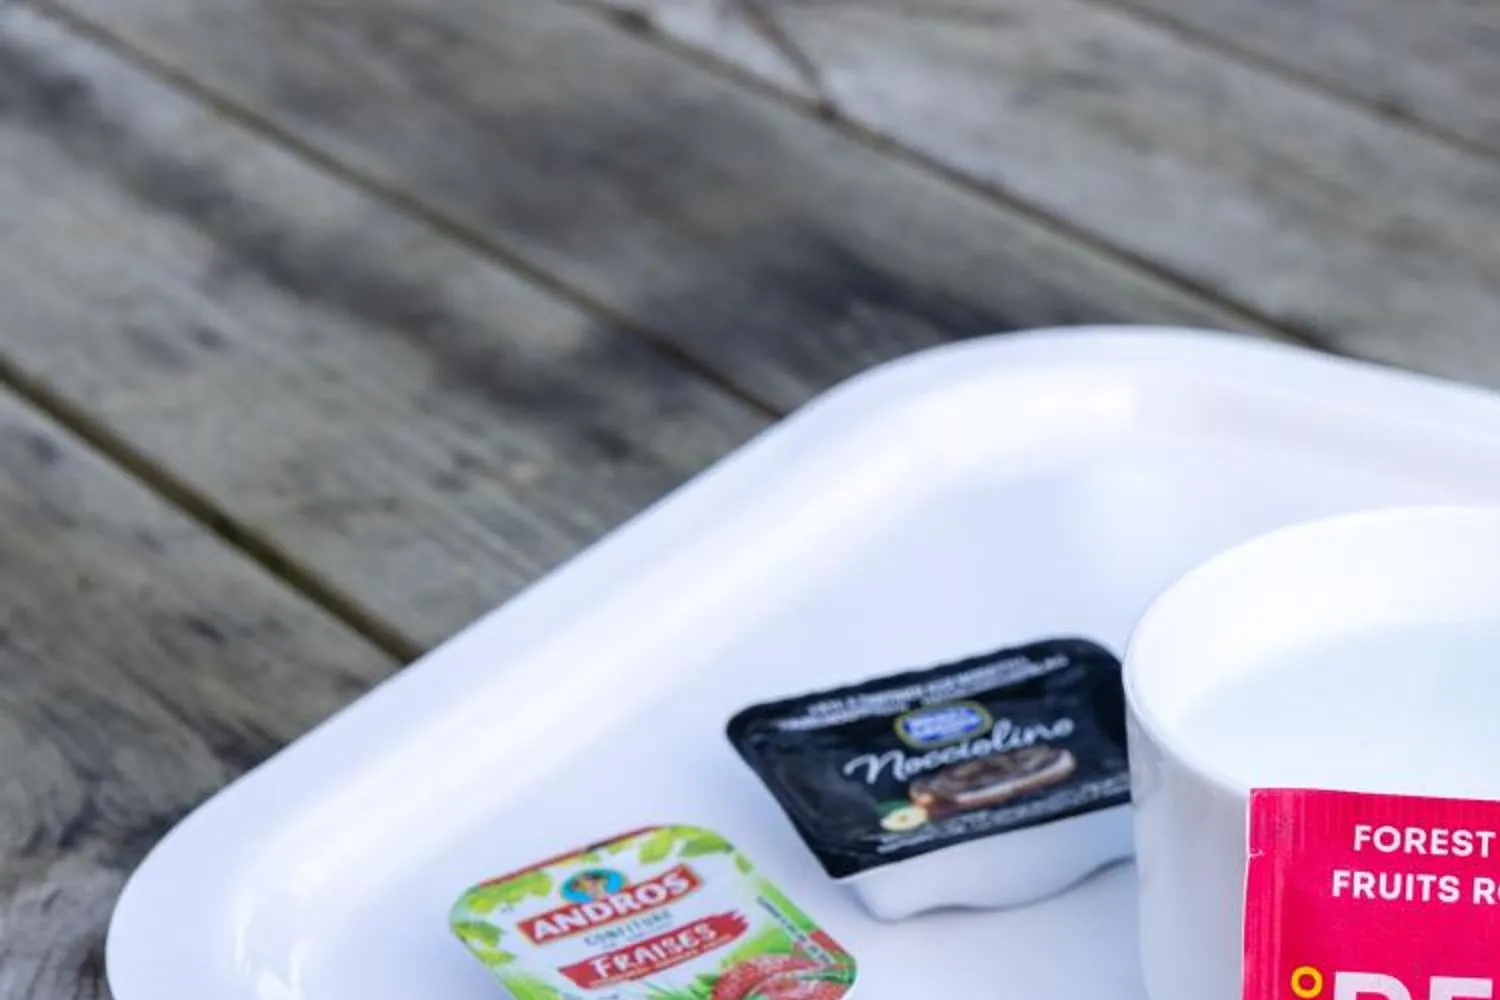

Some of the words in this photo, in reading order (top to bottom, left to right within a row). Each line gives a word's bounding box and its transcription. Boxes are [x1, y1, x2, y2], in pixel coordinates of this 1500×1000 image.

[1353, 824, 1497, 858] FOREST
[531, 870, 691, 941] ANDROS
[1331, 868, 1461, 904] FRUITS
[590, 922, 718, 979] FRAISES
